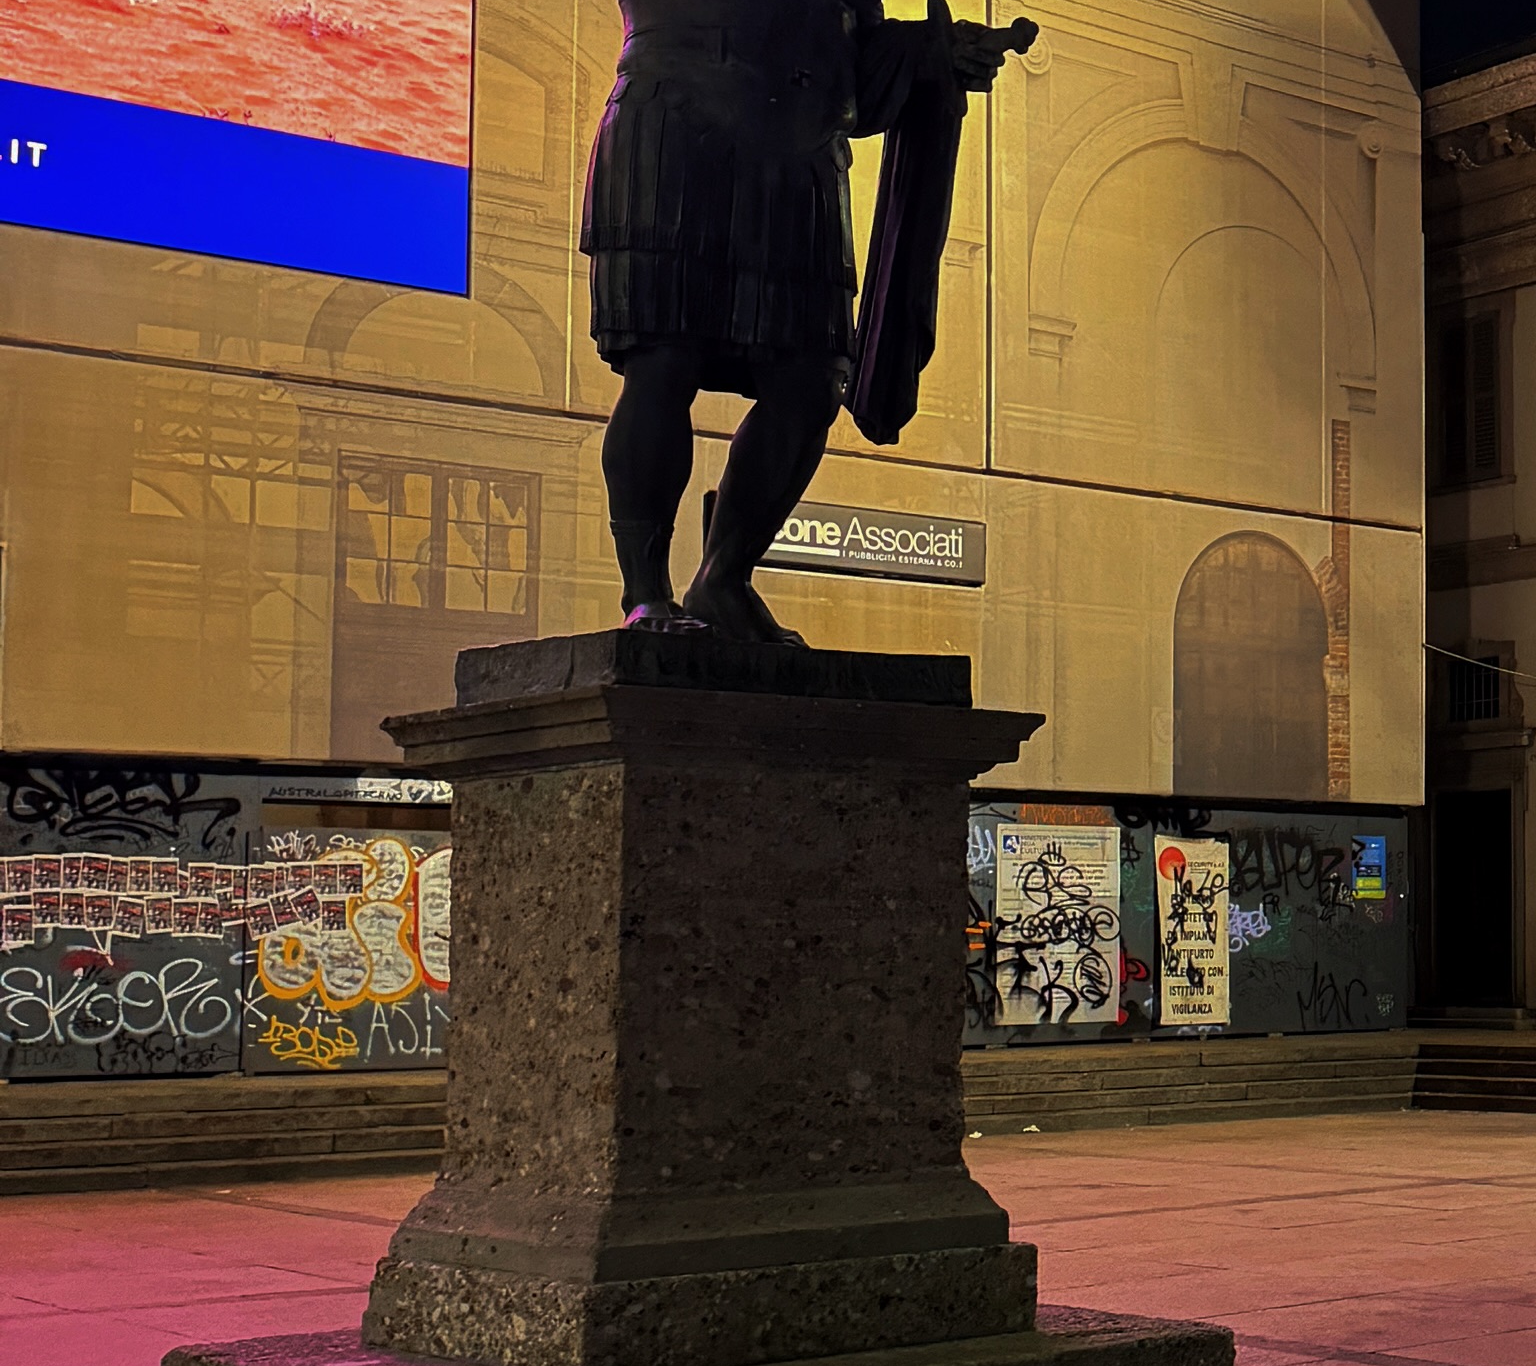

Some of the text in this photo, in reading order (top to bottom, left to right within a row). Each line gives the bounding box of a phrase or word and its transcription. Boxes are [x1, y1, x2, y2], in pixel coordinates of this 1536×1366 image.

[843, 516, 963, 558] Associati
[898, 556, 935, 566] ESTERNA
[1169, 985, 1214, 996] ISTITUTO DI
[1171, 1003, 1213, 1014] VIGILANZA
